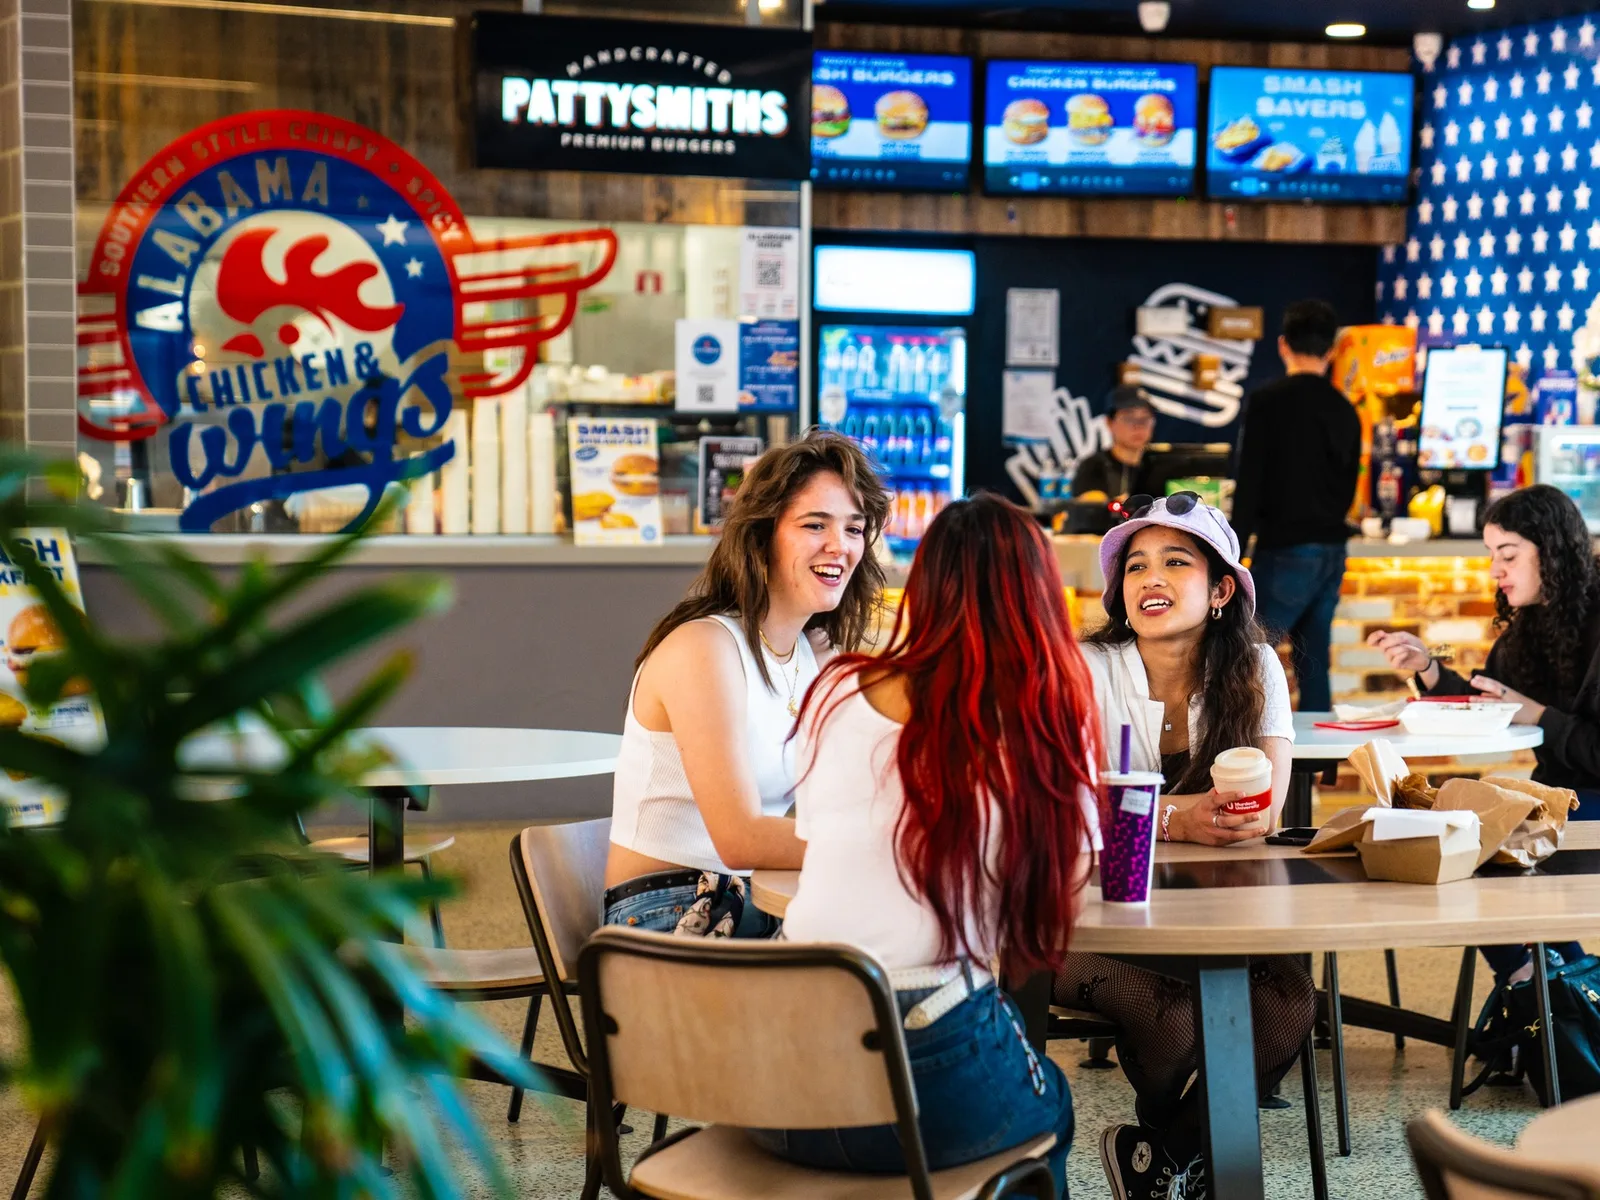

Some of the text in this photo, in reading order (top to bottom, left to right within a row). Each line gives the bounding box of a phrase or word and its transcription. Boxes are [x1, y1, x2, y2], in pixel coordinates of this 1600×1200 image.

[566, 46, 731, 85] HANDCRAFTED
[852, 68, 955, 86] BURGERS
[1263, 75, 1363, 96] SMASH
[502, 77, 788, 137] PATTYSMITHS
[1256, 96, 1366, 120] SAVERS
[561, 132, 736, 155] PREMIUM BURGERS
[100, 156, 185, 277] SOUTHERN
[191, 122, 272, 160] STYLE
[289, 121, 379, 161] CRISPY
[136, 157, 329, 332] ALABAMA
[186, 341, 382, 413] CHICKEN &
[578, 425, 649, 435] SMASH
